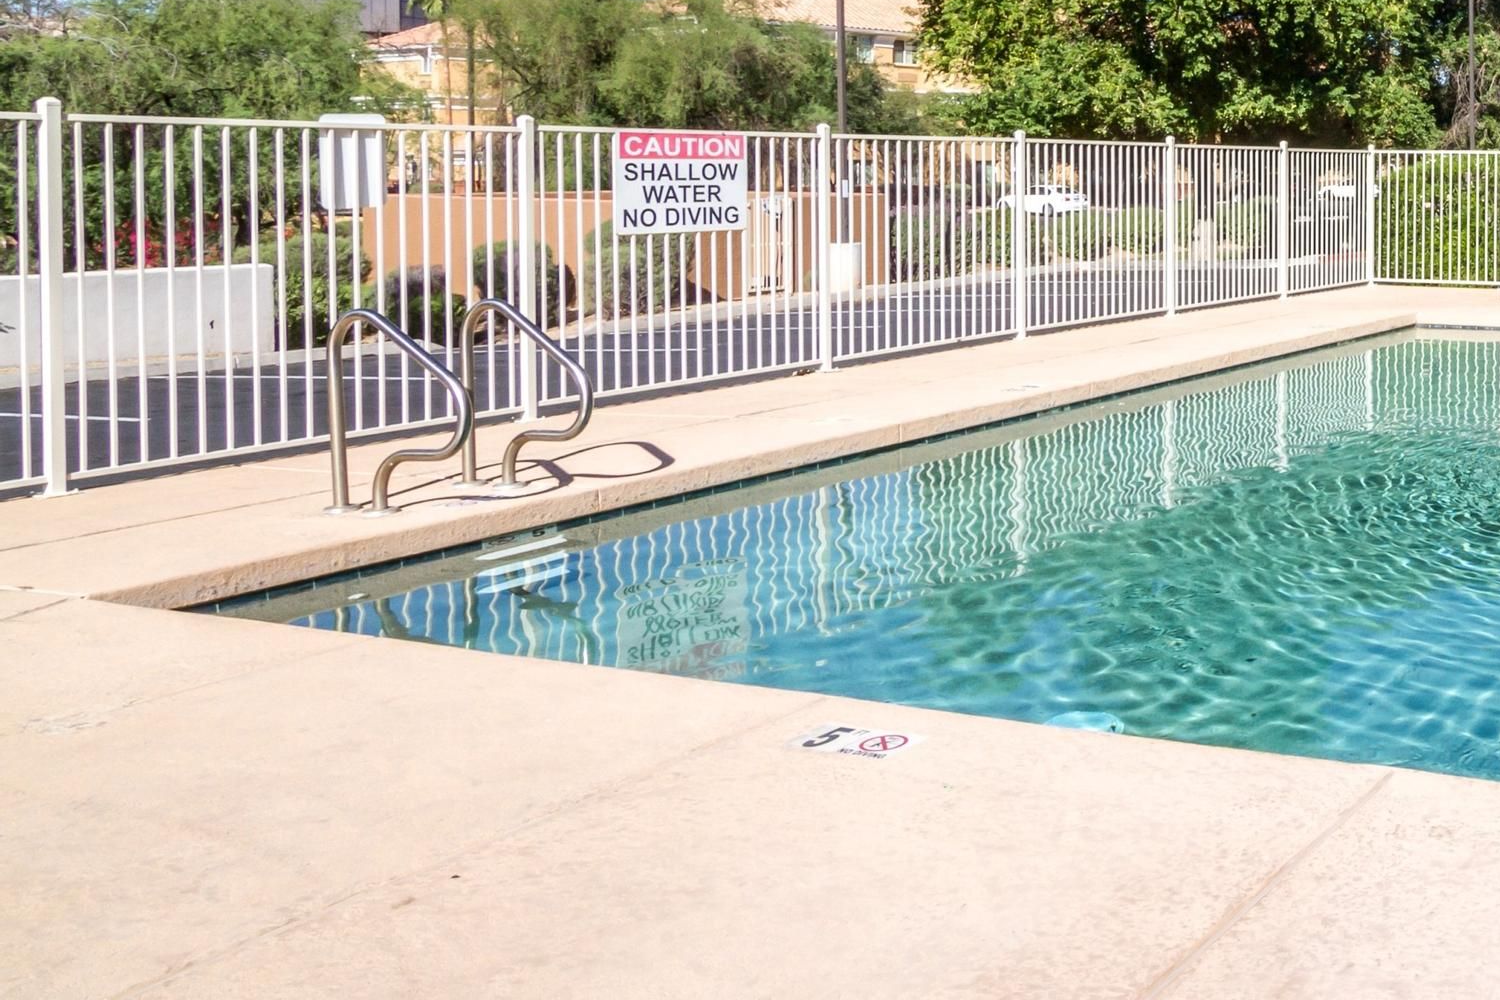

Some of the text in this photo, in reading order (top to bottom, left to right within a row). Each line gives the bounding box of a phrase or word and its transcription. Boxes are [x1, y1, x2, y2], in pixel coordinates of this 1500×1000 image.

[624, 136, 740, 157] CAUTION
[624, 163, 738, 181] SHALLOW
[642, 185, 722, 203] WATER
[623, 206, 739, 227] NO DIVING
[802, 727, 856, 747] 5
